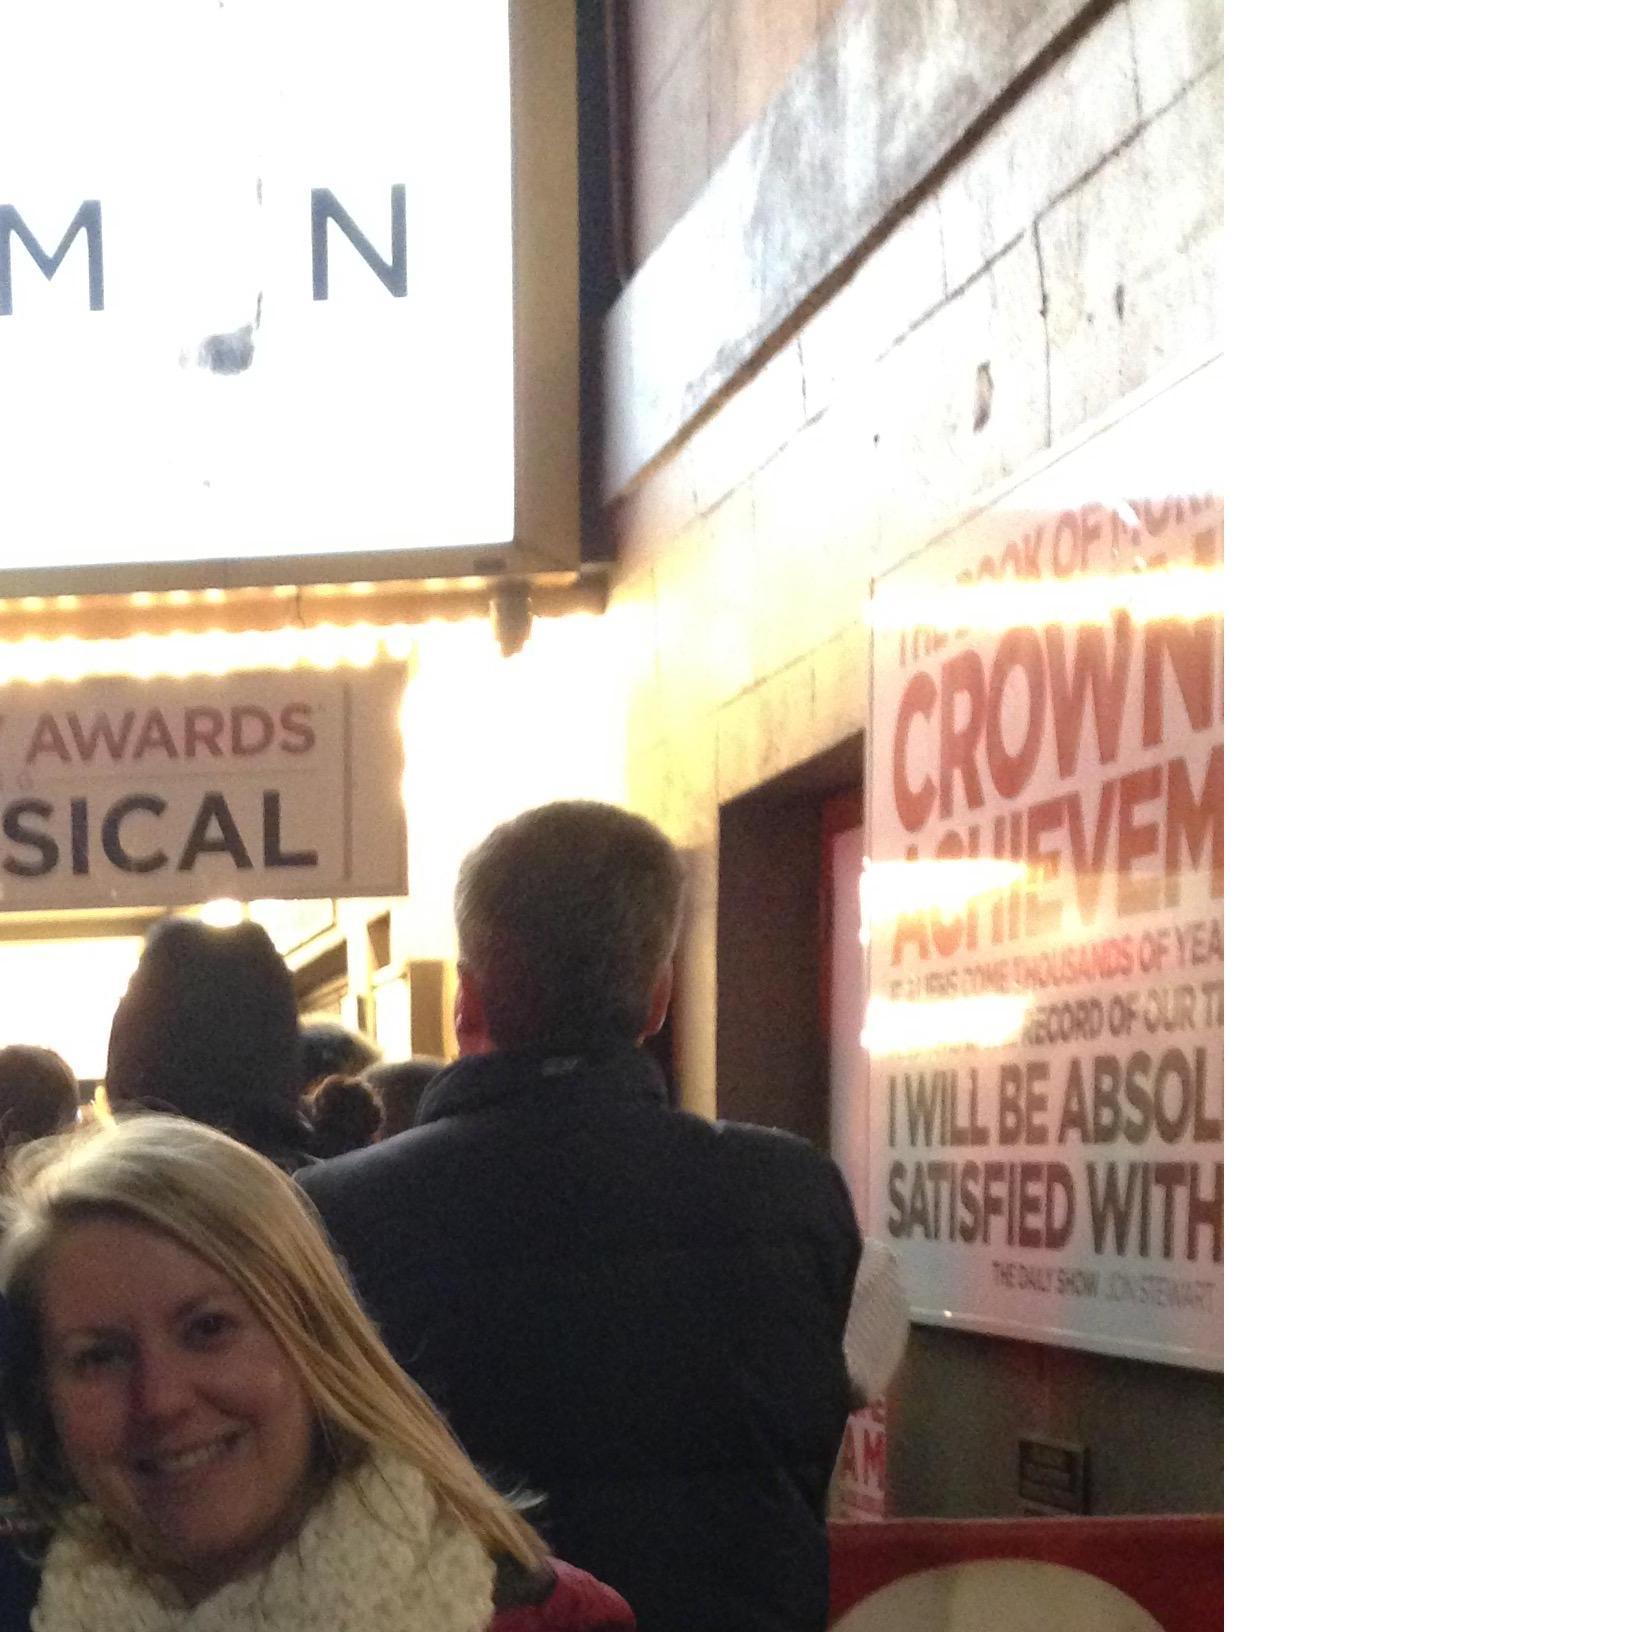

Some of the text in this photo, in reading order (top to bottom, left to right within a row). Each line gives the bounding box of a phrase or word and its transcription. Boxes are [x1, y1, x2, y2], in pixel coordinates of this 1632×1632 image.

[888, 1046, 1225, 1148] I WILL BE ABSOL
[887, 1160, 1225, 1264] SATISFIED WITH
